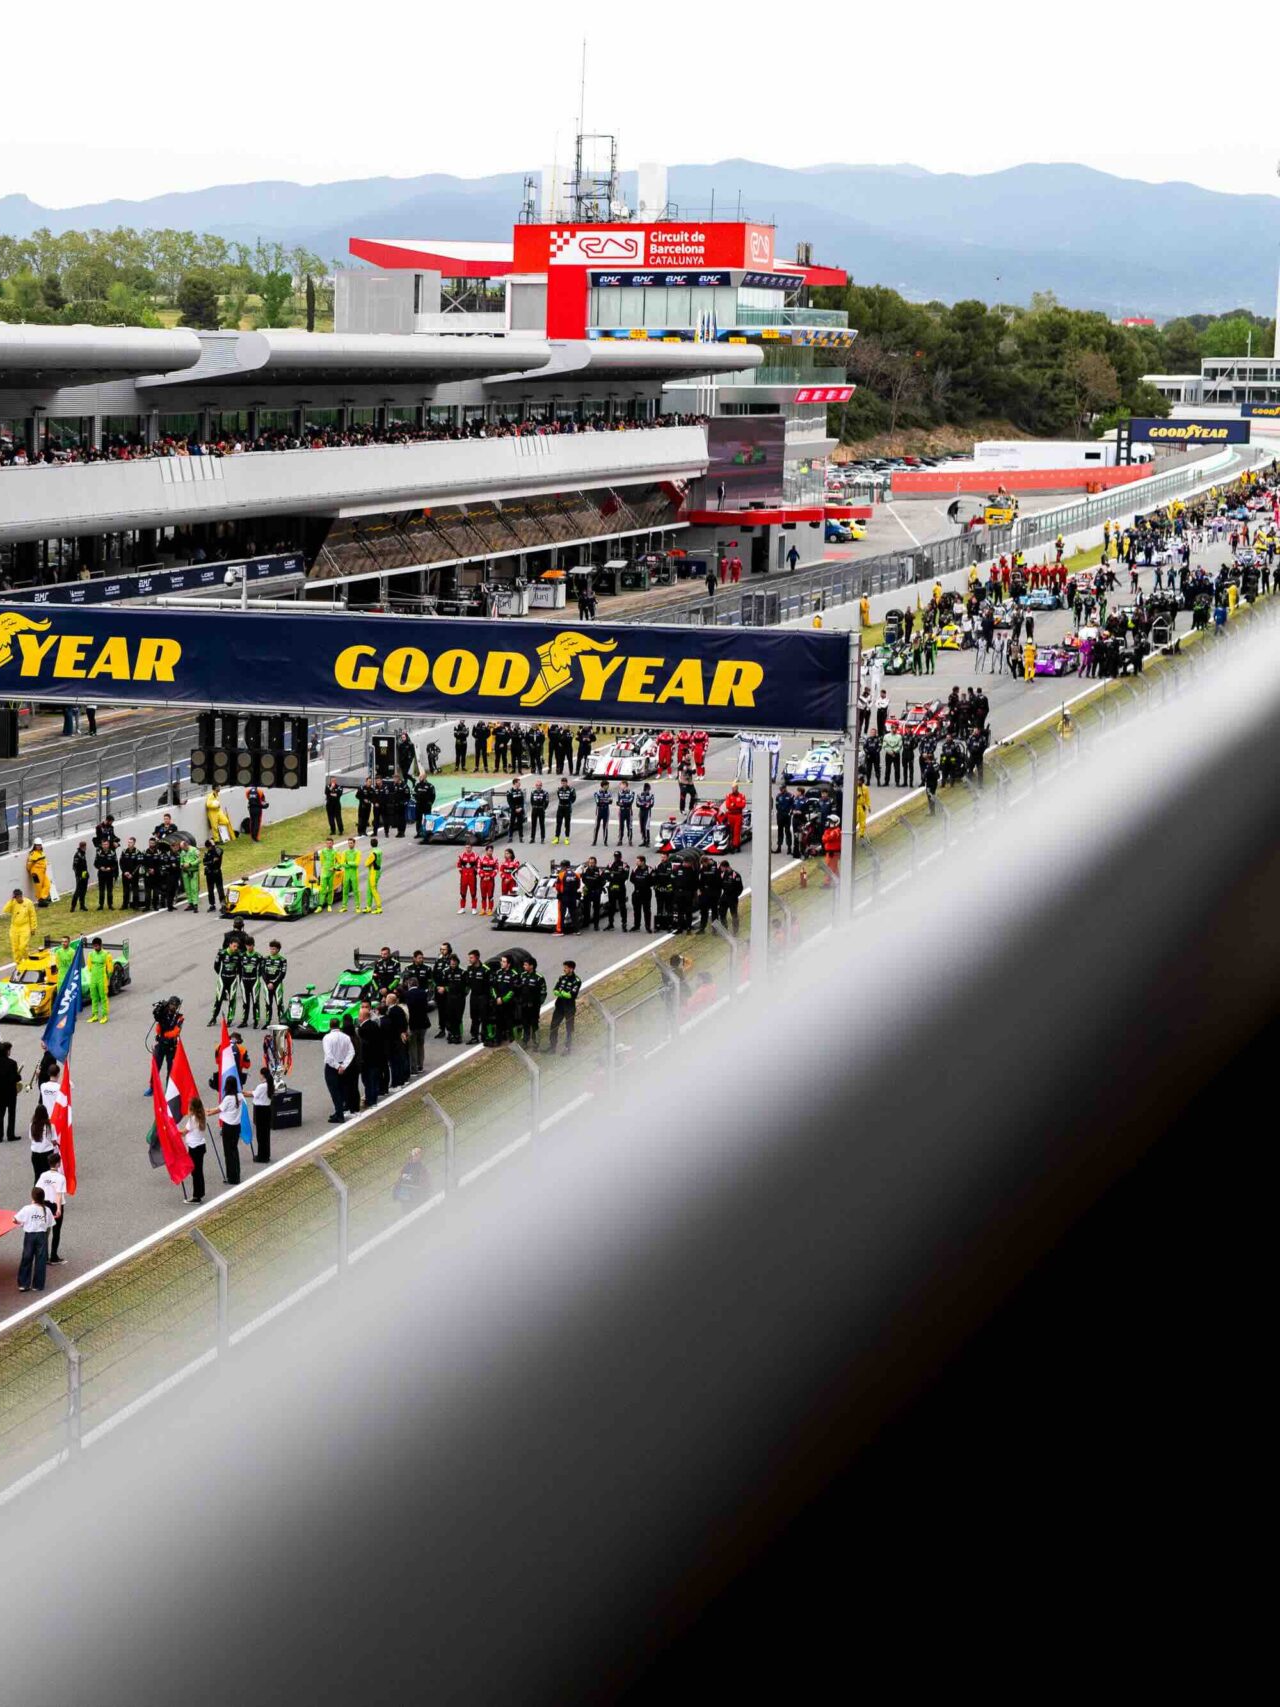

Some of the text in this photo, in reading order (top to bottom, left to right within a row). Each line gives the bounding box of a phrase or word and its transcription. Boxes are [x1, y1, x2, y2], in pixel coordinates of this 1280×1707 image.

[650, 231, 705, 242] Circuit de
[650, 243, 705, 254] Barcelona
[649, 256, 705, 265] CATALUNYA
[1149, 425, 1229, 439] GOODYEAR
[335, 632, 764, 708] GOODYEAR
